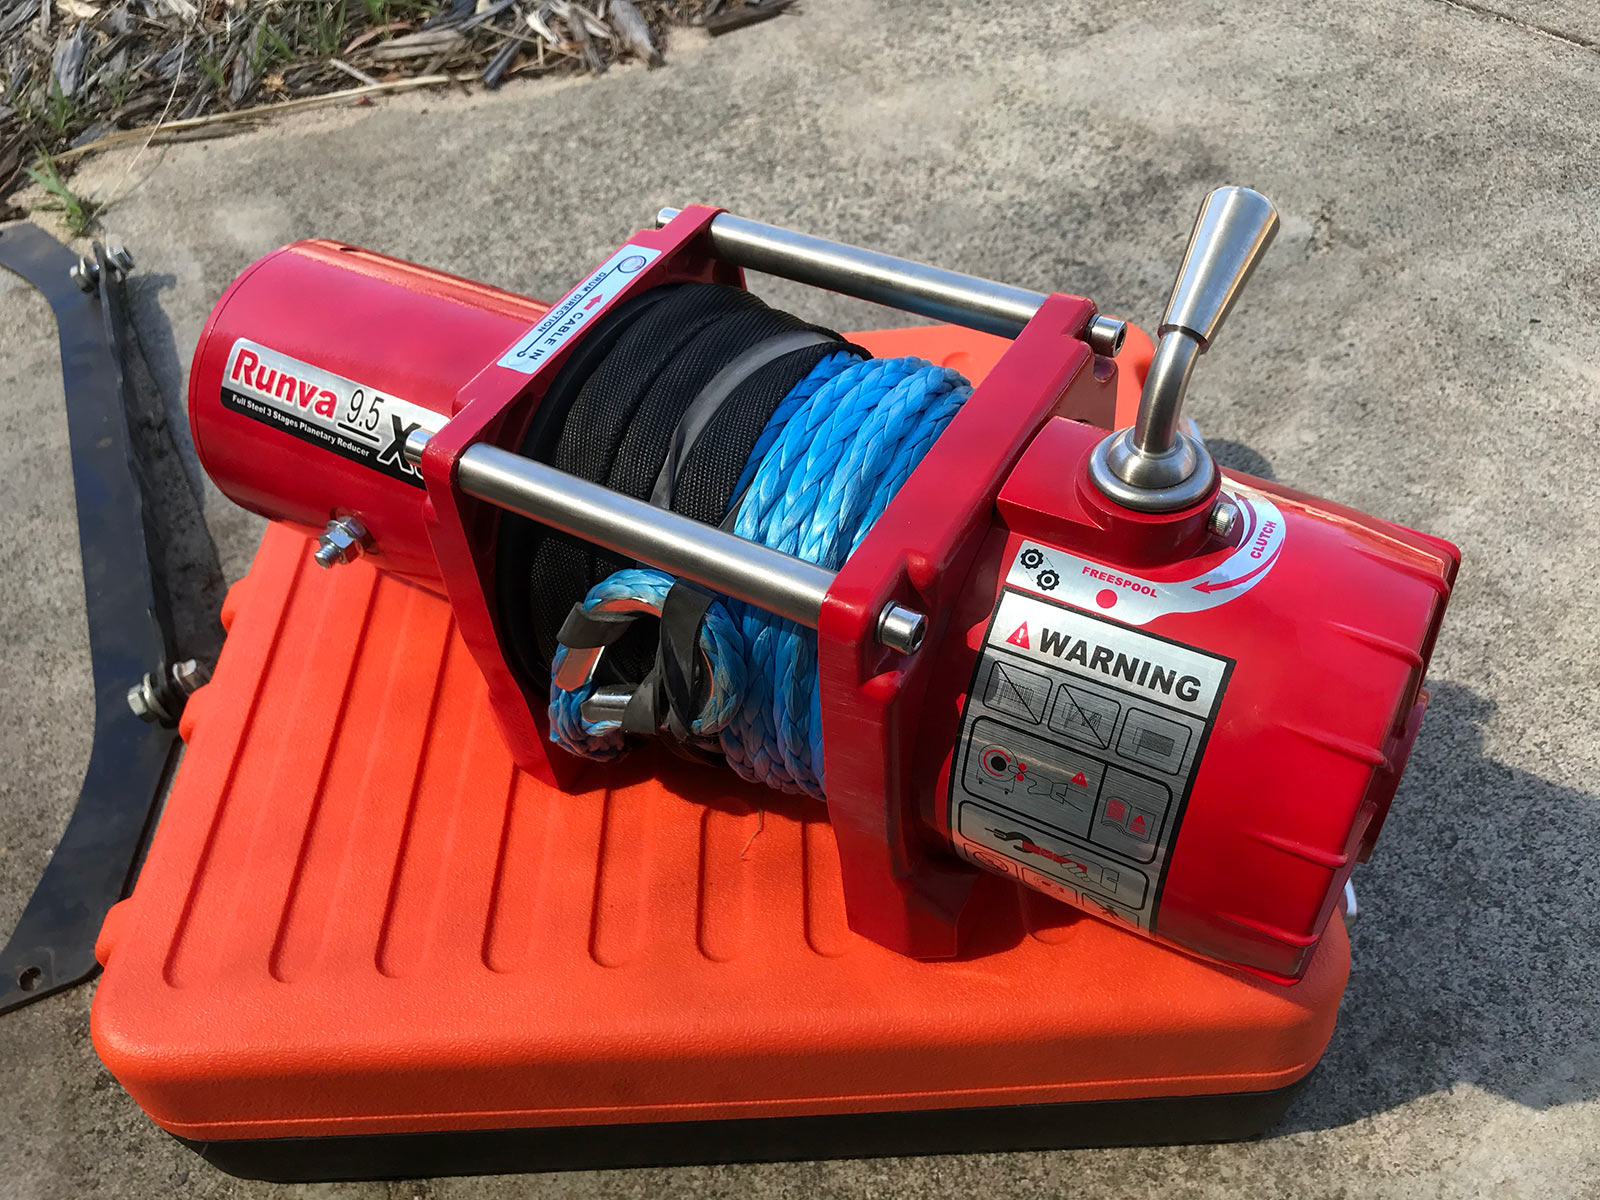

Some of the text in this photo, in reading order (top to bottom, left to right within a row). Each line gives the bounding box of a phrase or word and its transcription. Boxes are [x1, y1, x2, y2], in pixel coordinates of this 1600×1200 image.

[537, 271, 607, 333] DRUM DIRECTION
[528, 312, 584, 360] CABLE IN
[231, 347, 339, 419] Runva
[346, 388, 385, 431] 9.5
[232, 394, 370, 457] Full Steel 3 Stages Planetary Reducer
[1250, 520, 1277, 560] CLUTCH
[1081, 566, 1158, 599] FREESPOOL
[1039, 627, 1201, 702] WARNING
